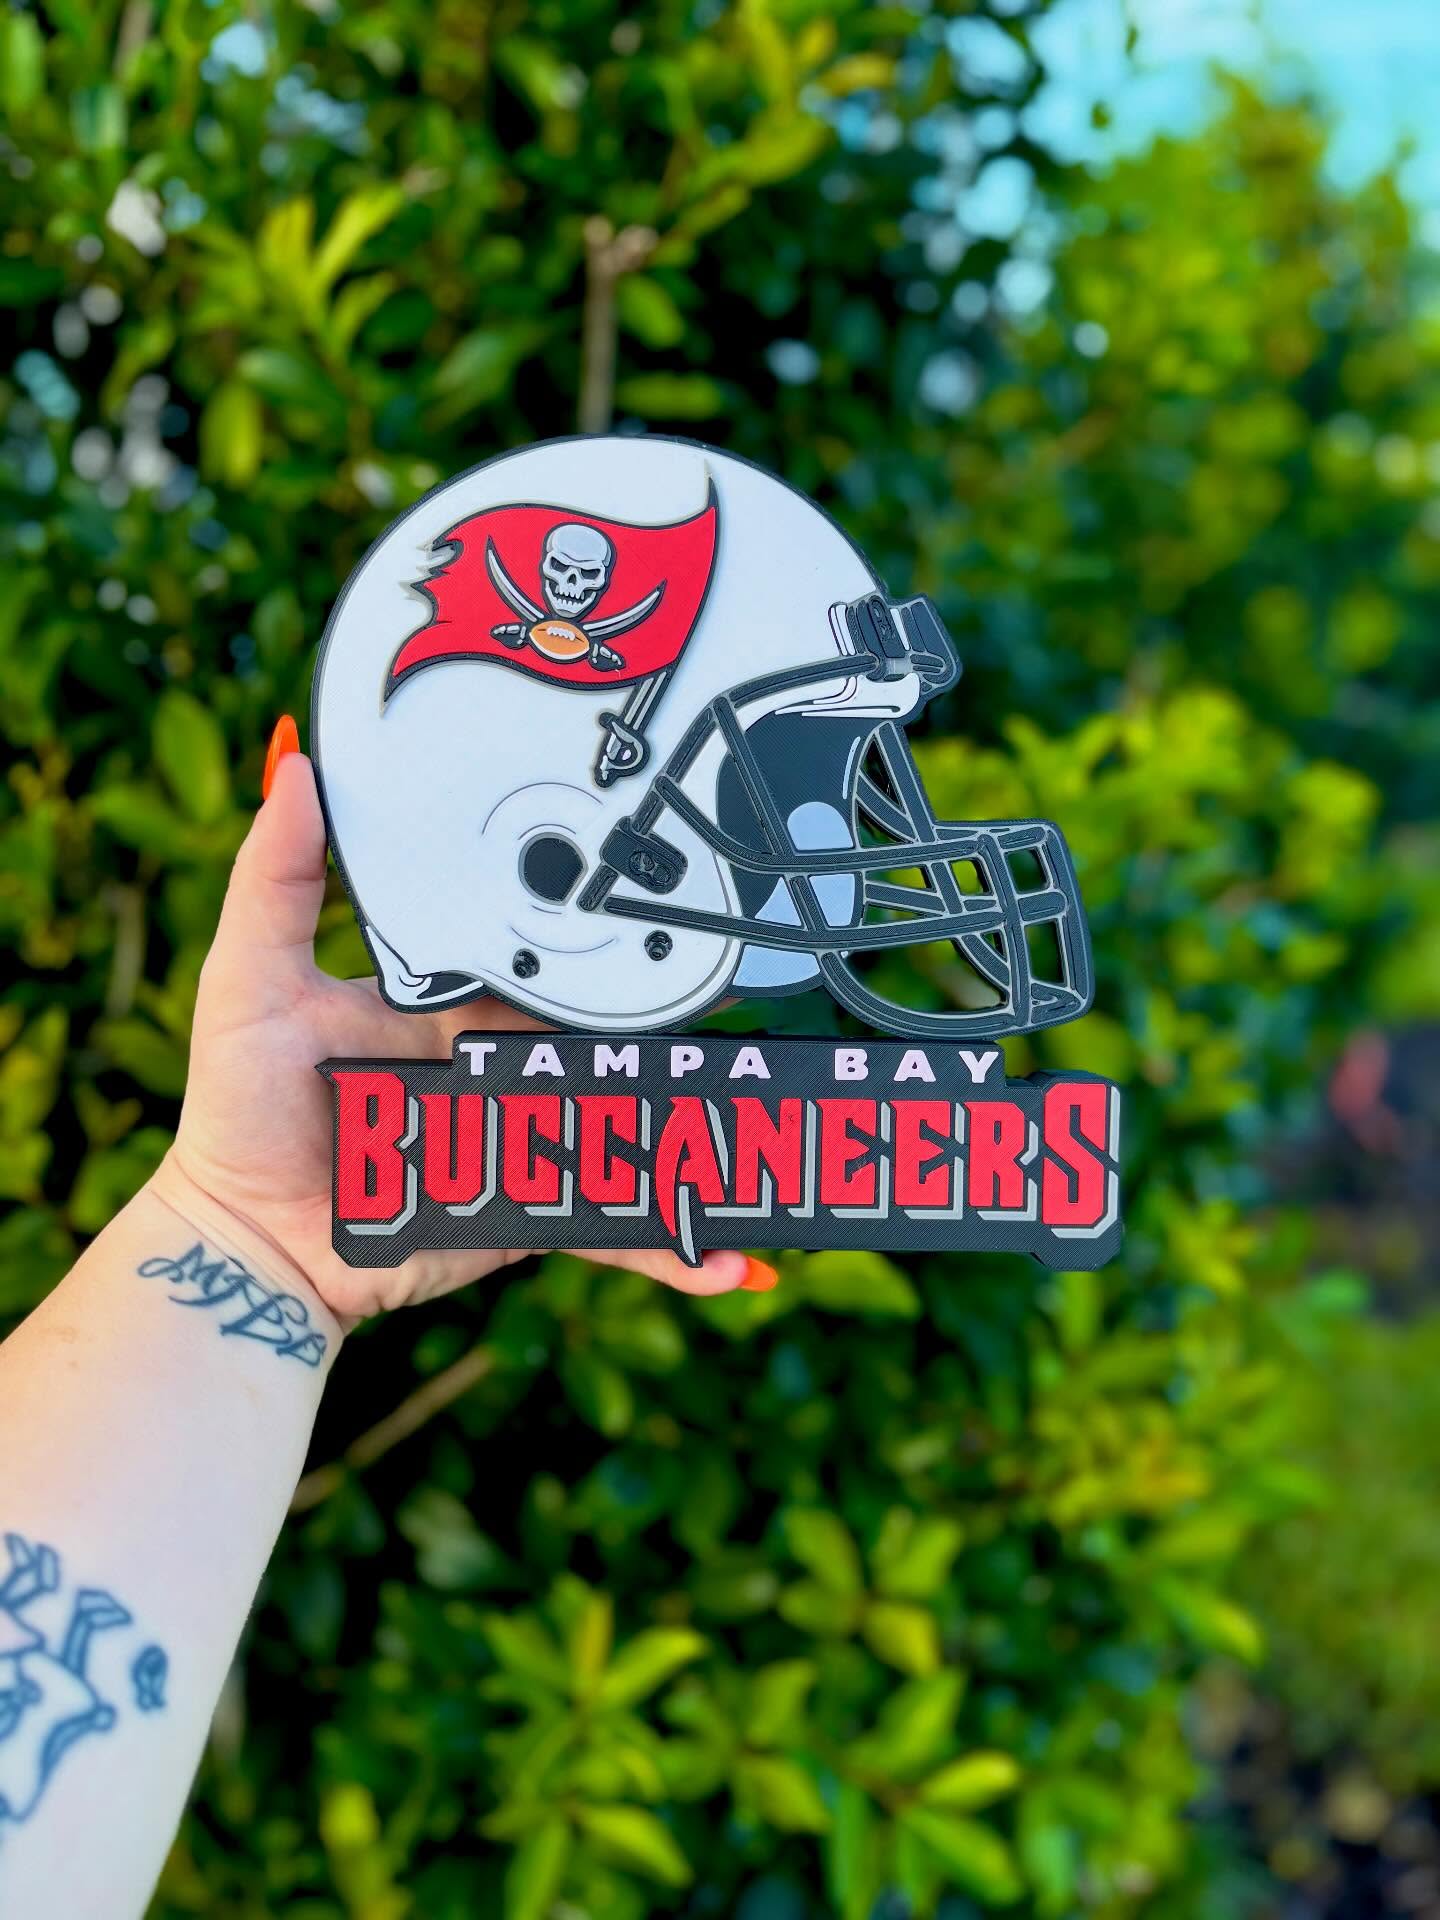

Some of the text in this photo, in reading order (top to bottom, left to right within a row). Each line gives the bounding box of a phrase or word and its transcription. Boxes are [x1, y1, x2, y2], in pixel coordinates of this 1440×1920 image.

[458, 1042, 999, 1083] TAMPA BAY
[331, 1072, 1116, 1242] BUCCANEERS
